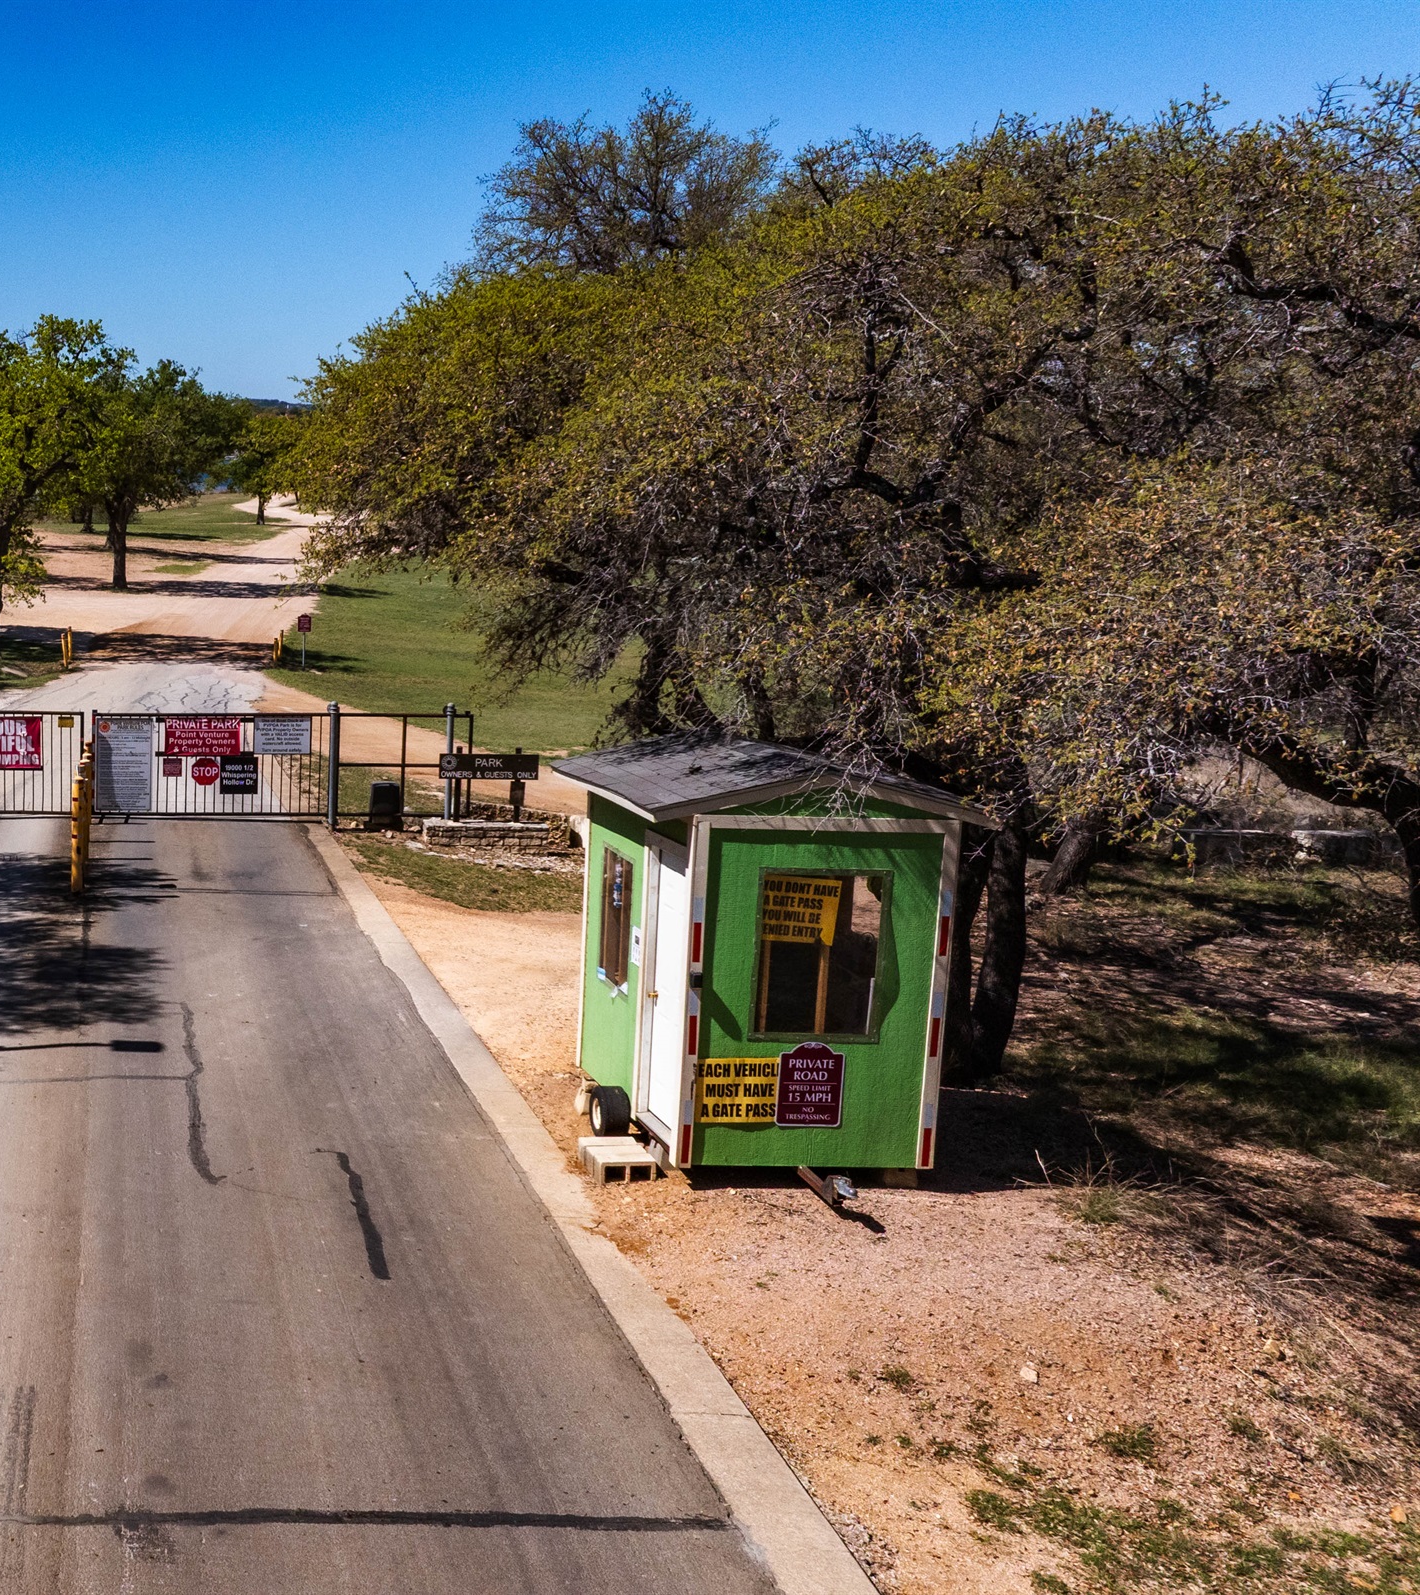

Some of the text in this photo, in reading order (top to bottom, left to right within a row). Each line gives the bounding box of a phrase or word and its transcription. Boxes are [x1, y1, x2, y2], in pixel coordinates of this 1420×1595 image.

[166, 719, 240, 729] PRIVATE PARK
[475, 758, 503, 767] PARK
[193, 767, 218, 776] STOP
[764, 880, 840, 897] YOU DONT HAVE
[764, 895, 823, 910] A GATE PASS
[763, 908, 821, 924] YOU WILL BE
[762, 923, 823, 937] ENIED ENTRY
[698, 1063, 731, 1077] EACH
[789, 1059, 835, 1069] PRIVATE
[794, 1071, 828, 1080] ROAD
[706, 1084, 774, 1097] MUST HAVE
[789, 1093, 831, 1102] 15 MPH
[701, 1103, 776, 1117] A GATE PASS
